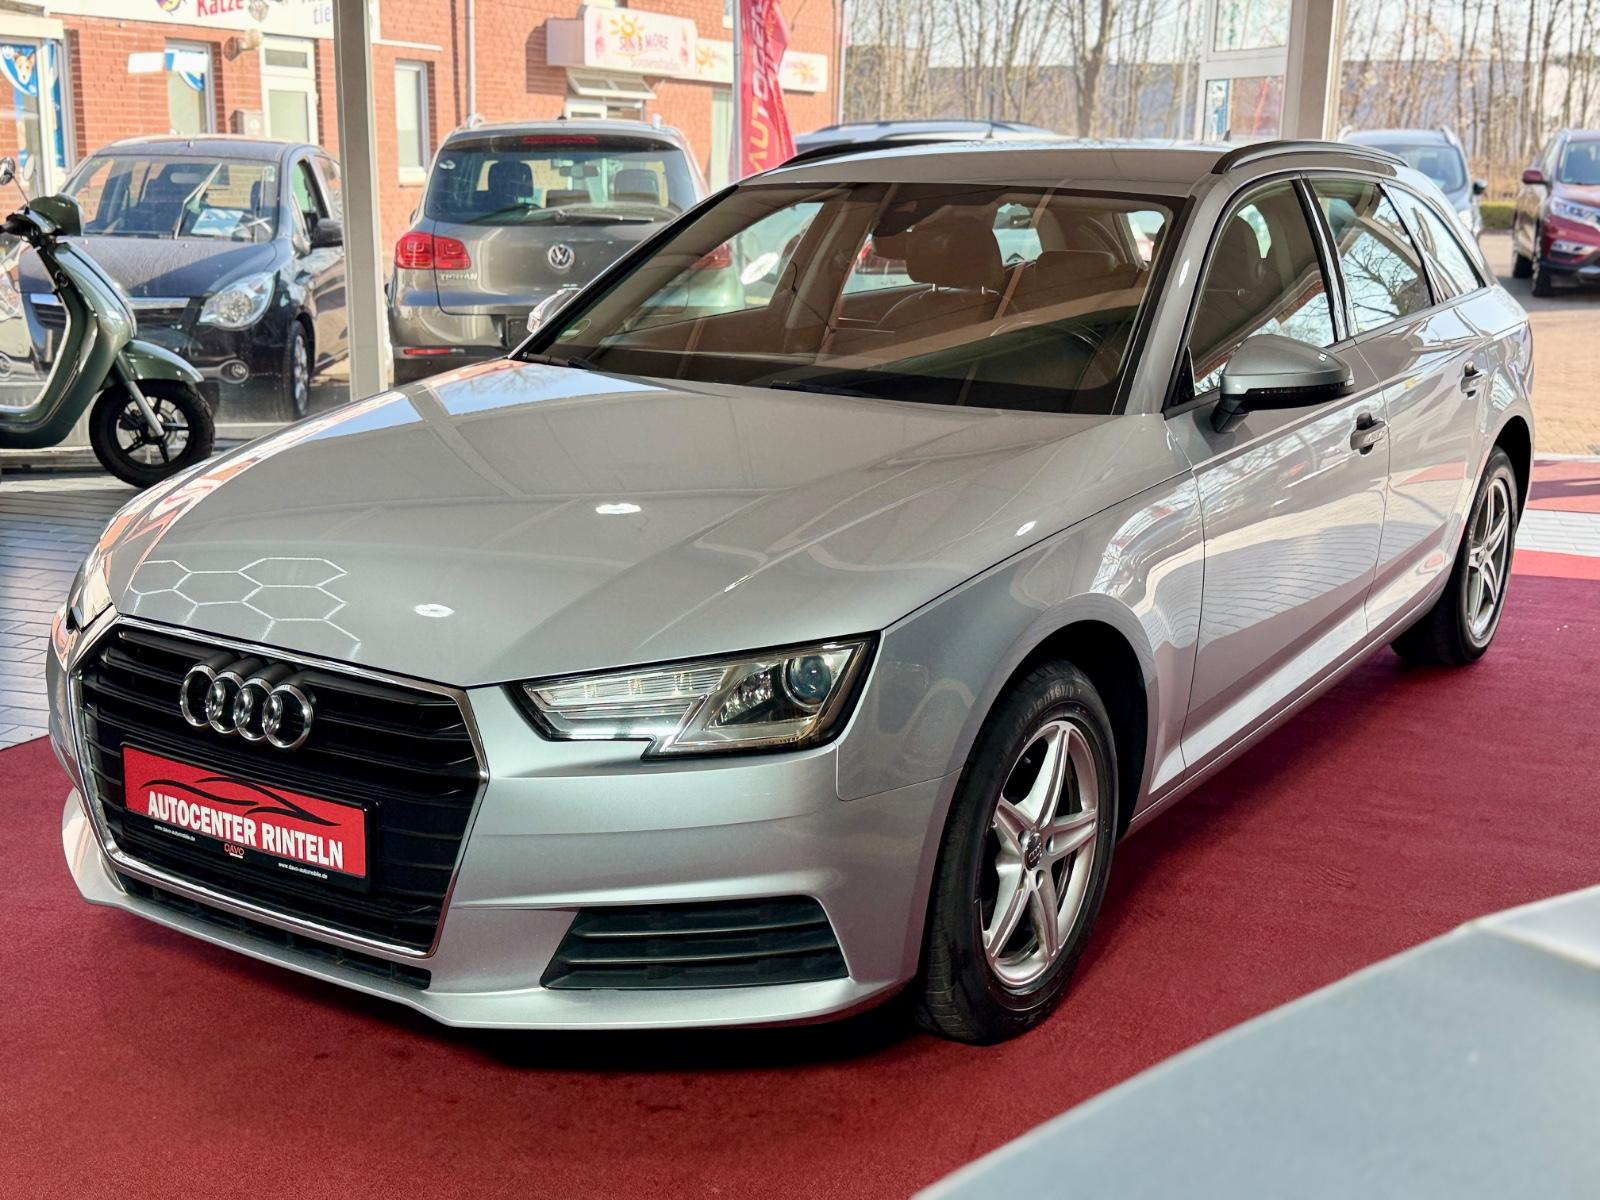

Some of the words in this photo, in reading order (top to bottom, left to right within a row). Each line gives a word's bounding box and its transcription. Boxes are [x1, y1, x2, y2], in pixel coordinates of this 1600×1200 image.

[148, 790, 257, 847] AUTOCENTER
[261, 822, 344, 869] RINTELN
[223, 843, 245, 856] DAVO
